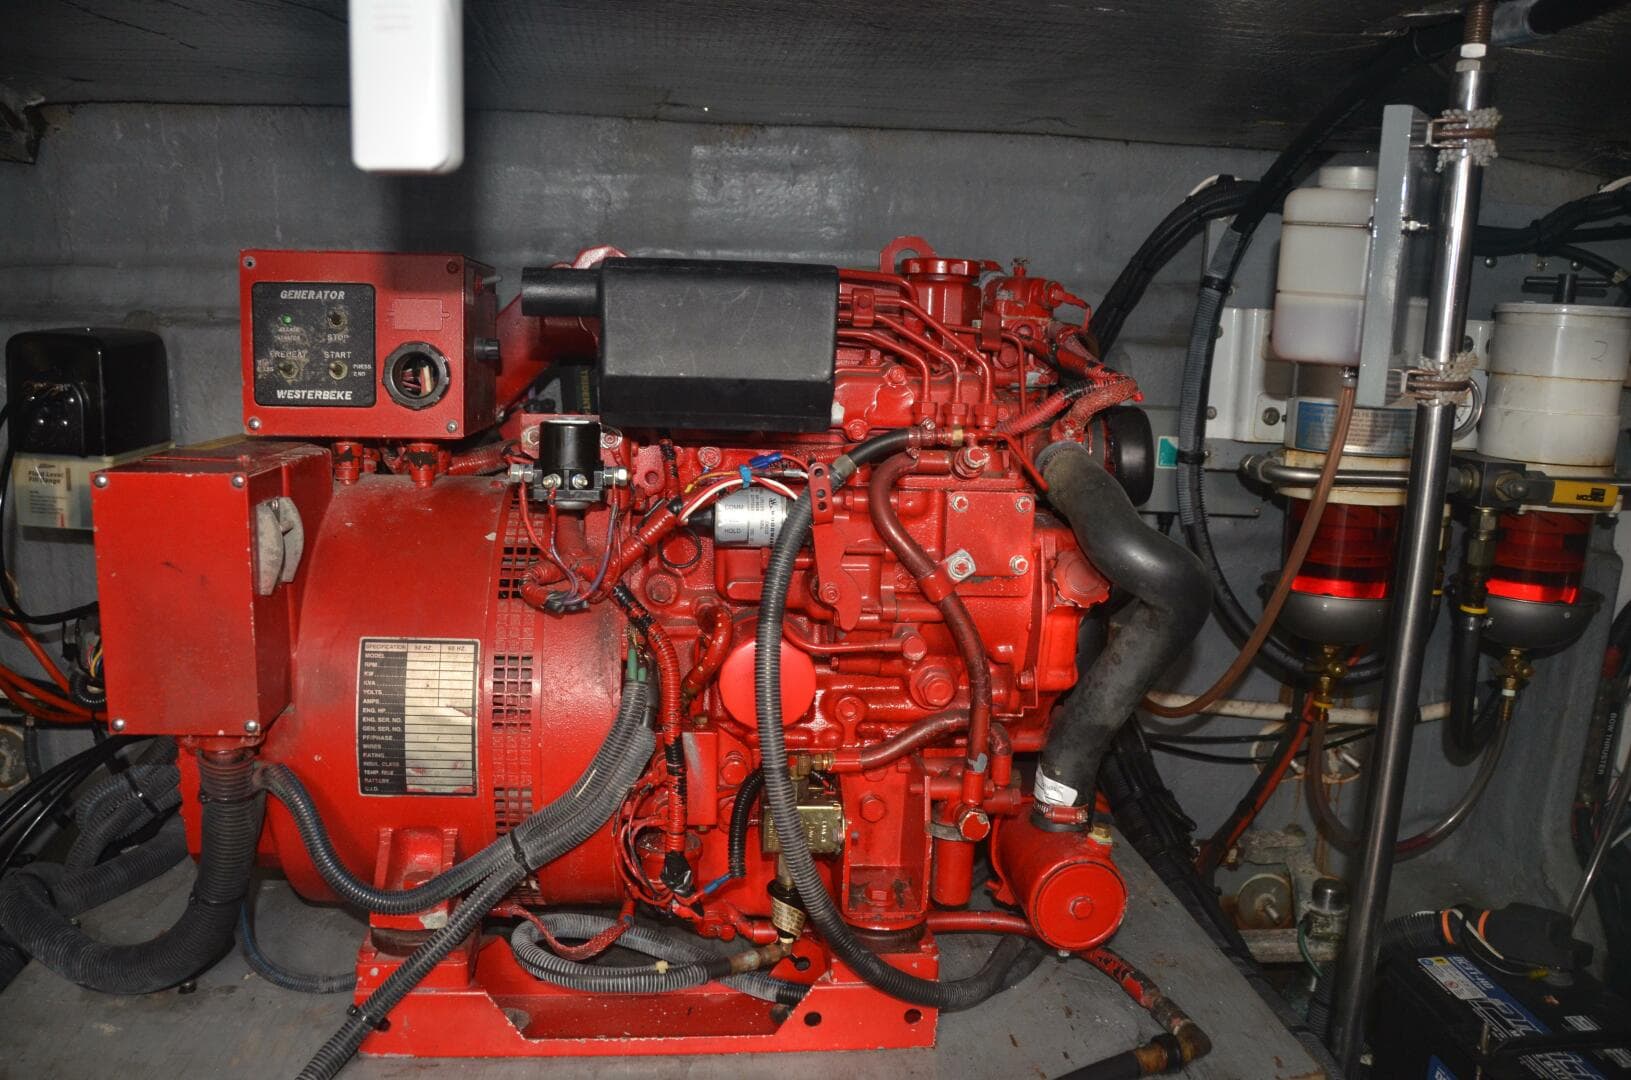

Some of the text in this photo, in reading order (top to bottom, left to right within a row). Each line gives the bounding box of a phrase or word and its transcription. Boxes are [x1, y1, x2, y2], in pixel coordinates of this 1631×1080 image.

[280, 290, 346, 300] GENERATOR
[324, 351, 352, 359] START
[276, 390, 353, 400] WESTERBEKE
[1596, 712, 1617, 776] BOW THRUSTER
